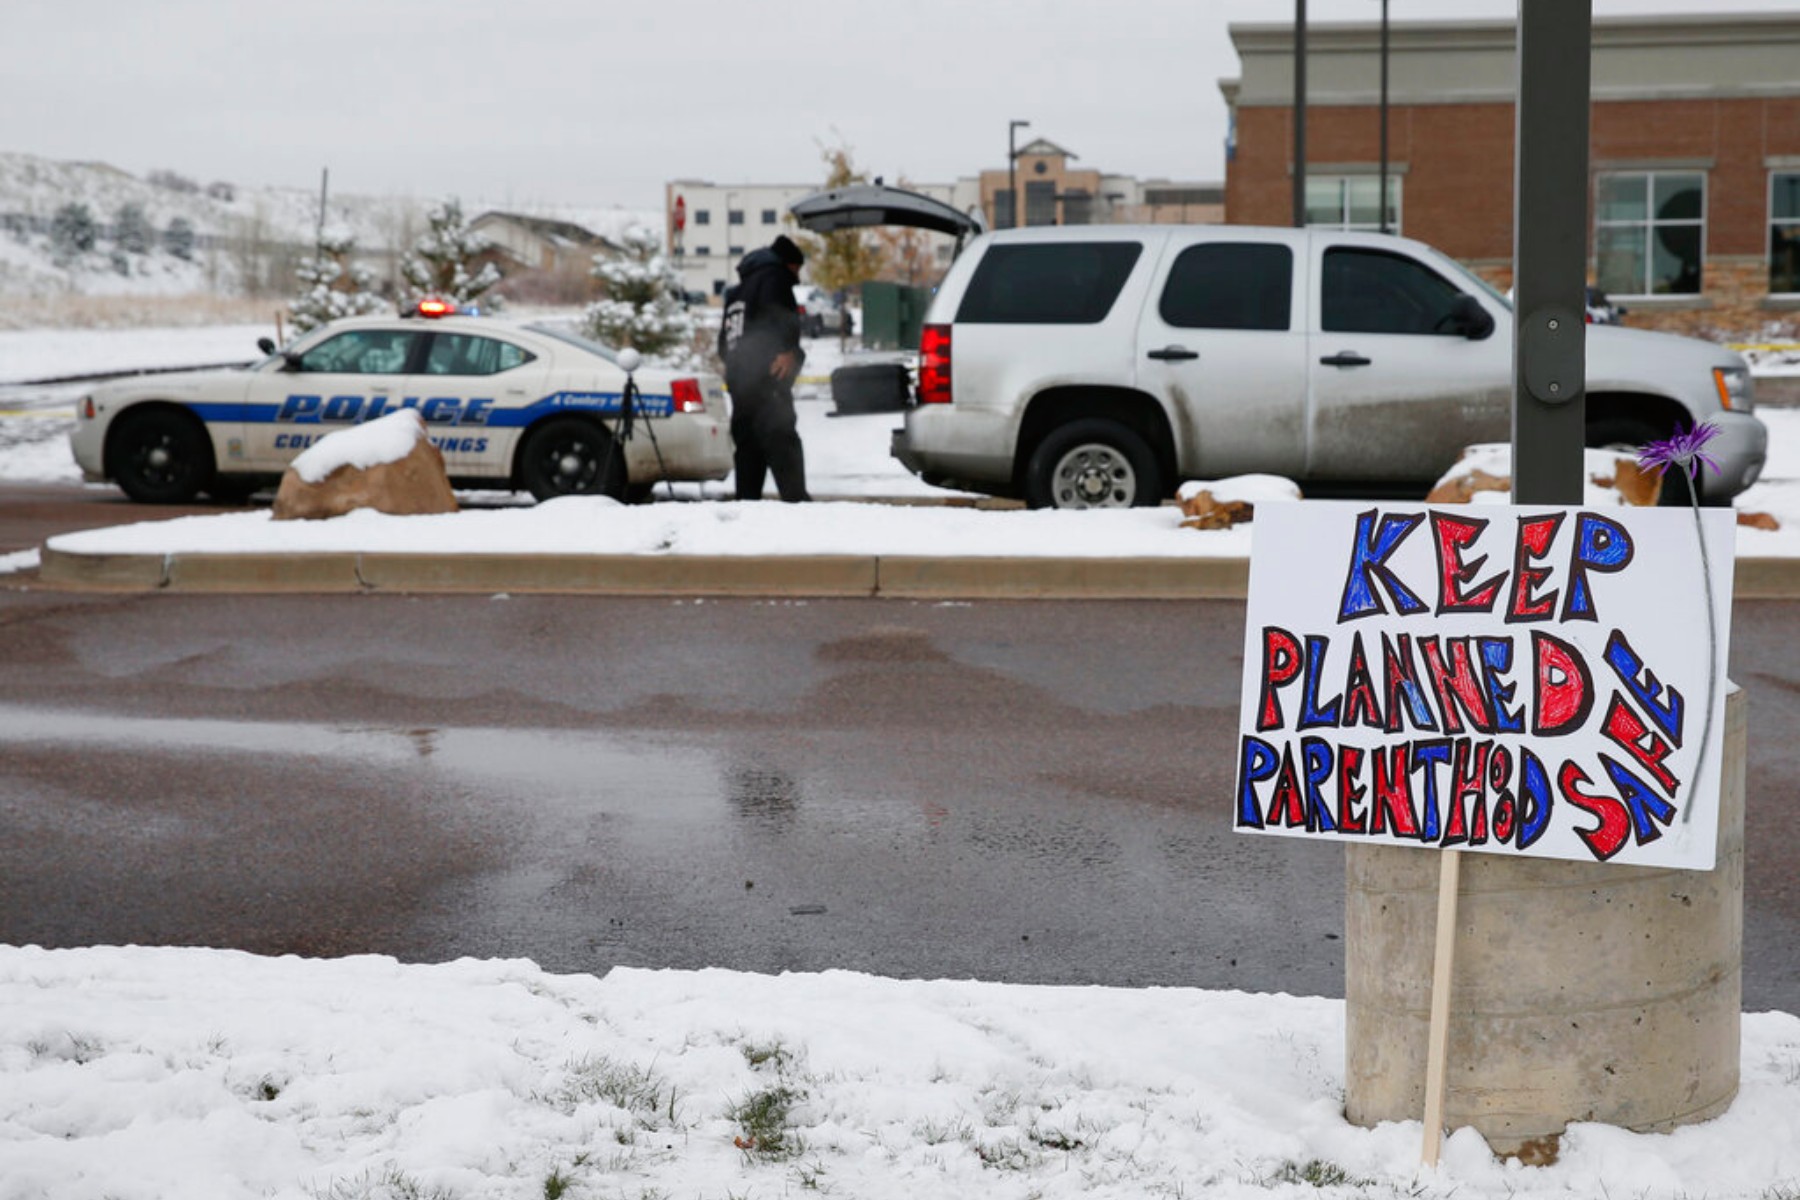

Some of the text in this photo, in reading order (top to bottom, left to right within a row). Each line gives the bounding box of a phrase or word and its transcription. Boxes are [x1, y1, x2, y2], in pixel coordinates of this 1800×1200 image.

[431, 437, 488, 452] INGS
[563, 394, 607, 408] Century
[1338, 508, 1635, 623] KEEP
[1256, 625, 1596, 736] PLANNED
[1237, 735, 1555, 850] PARENTHOOD
[1557, 628, 1685, 861] SAFE
